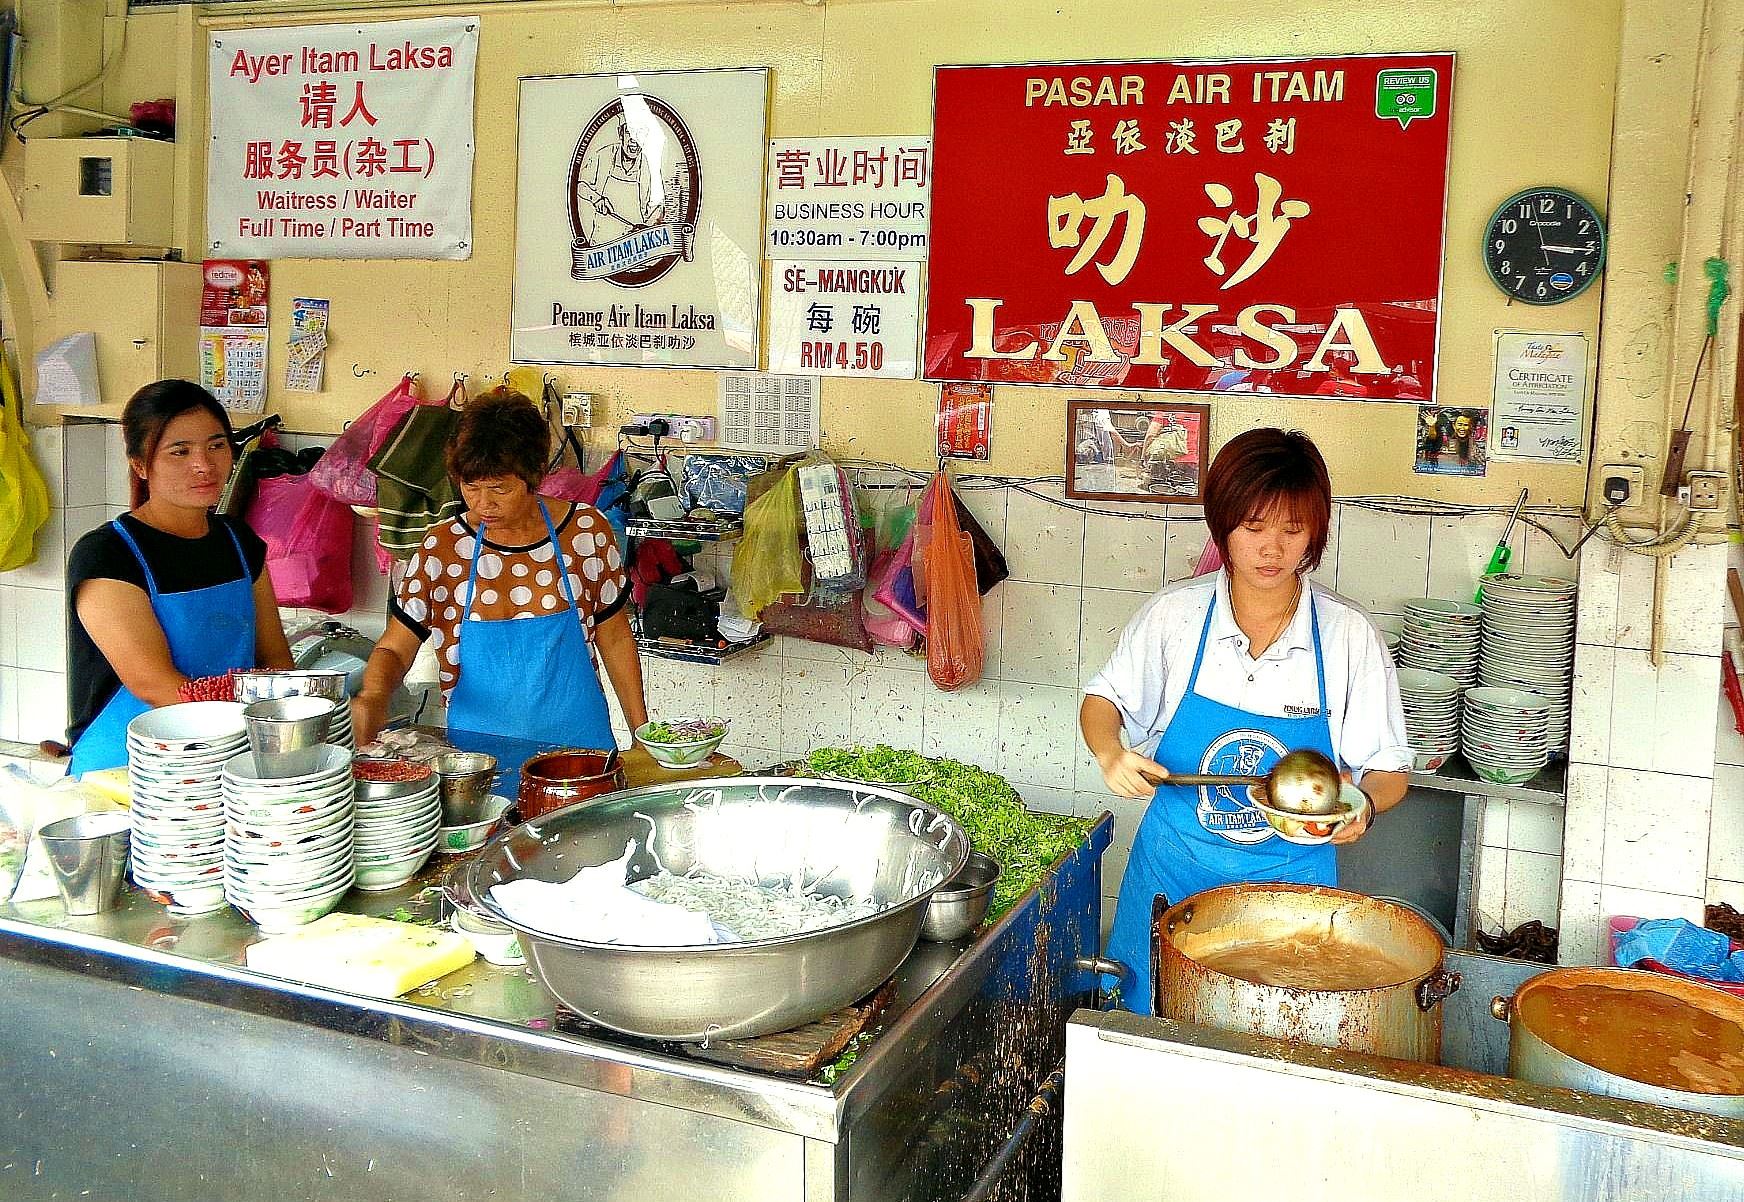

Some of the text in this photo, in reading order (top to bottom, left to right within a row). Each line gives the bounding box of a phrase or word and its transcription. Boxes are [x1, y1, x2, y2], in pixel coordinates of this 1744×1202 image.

[230, 41, 454, 83] Ayer Itam Laksa
[1025, 70, 1345, 107] PASAR AIR ITAM
[1383, 76, 1430, 85] REVIEW US
[299, 80, 379, 129] 请人
[243, 137, 437, 181] 服务员(杂工)
[775, 146, 928, 190] 营业时间
[257, 189, 417, 211] Waitress / Waiter
[1539, 199, 1555, 214] 12
[774, 202, 926, 219] BUSINESS HOUR
[1520, 204, 1531, 219] 11
[1566, 204, 1572, 219] 1
[239, 216, 434, 239] Full Time / Part Time
[1048, 172, 1311, 290] 叻沙
[1501, 219, 1517, 234] 10
[1578, 220, 1591, 235] 2
[586, 251, 607, 269] AIR
[606, 239, 635, 264] ITAM
[634, 227, 671, 253] LAKSA
[770, 230, 842, 246] 10:30am
[859, 230, 926, 250] 7:00pm
[1495, 240, 1505, 254] 9
[1584, 240, 1596, 255] 3
[1501, 261, 1511, 275] 8
[1576, 262, 1588, 276] 4
[783, 268, 906, 294] SE-MANGKUK
[1513, 275, 1526, 291] 7
[1537, 281, 1547, 297] 6
[551, 302, 716, 331] Penang Air Itam Laksa
[806, 302, 881, 335] 每碗
[963, 298, 1390, 375] LAKSA
[800, 341, 884, 370] RM4.50
[1509, 369, 1574, 383] CERTIFICATE
[1208, 814, 1223, 825] AIR
[1225, 813, 1245, 825] ITAM
